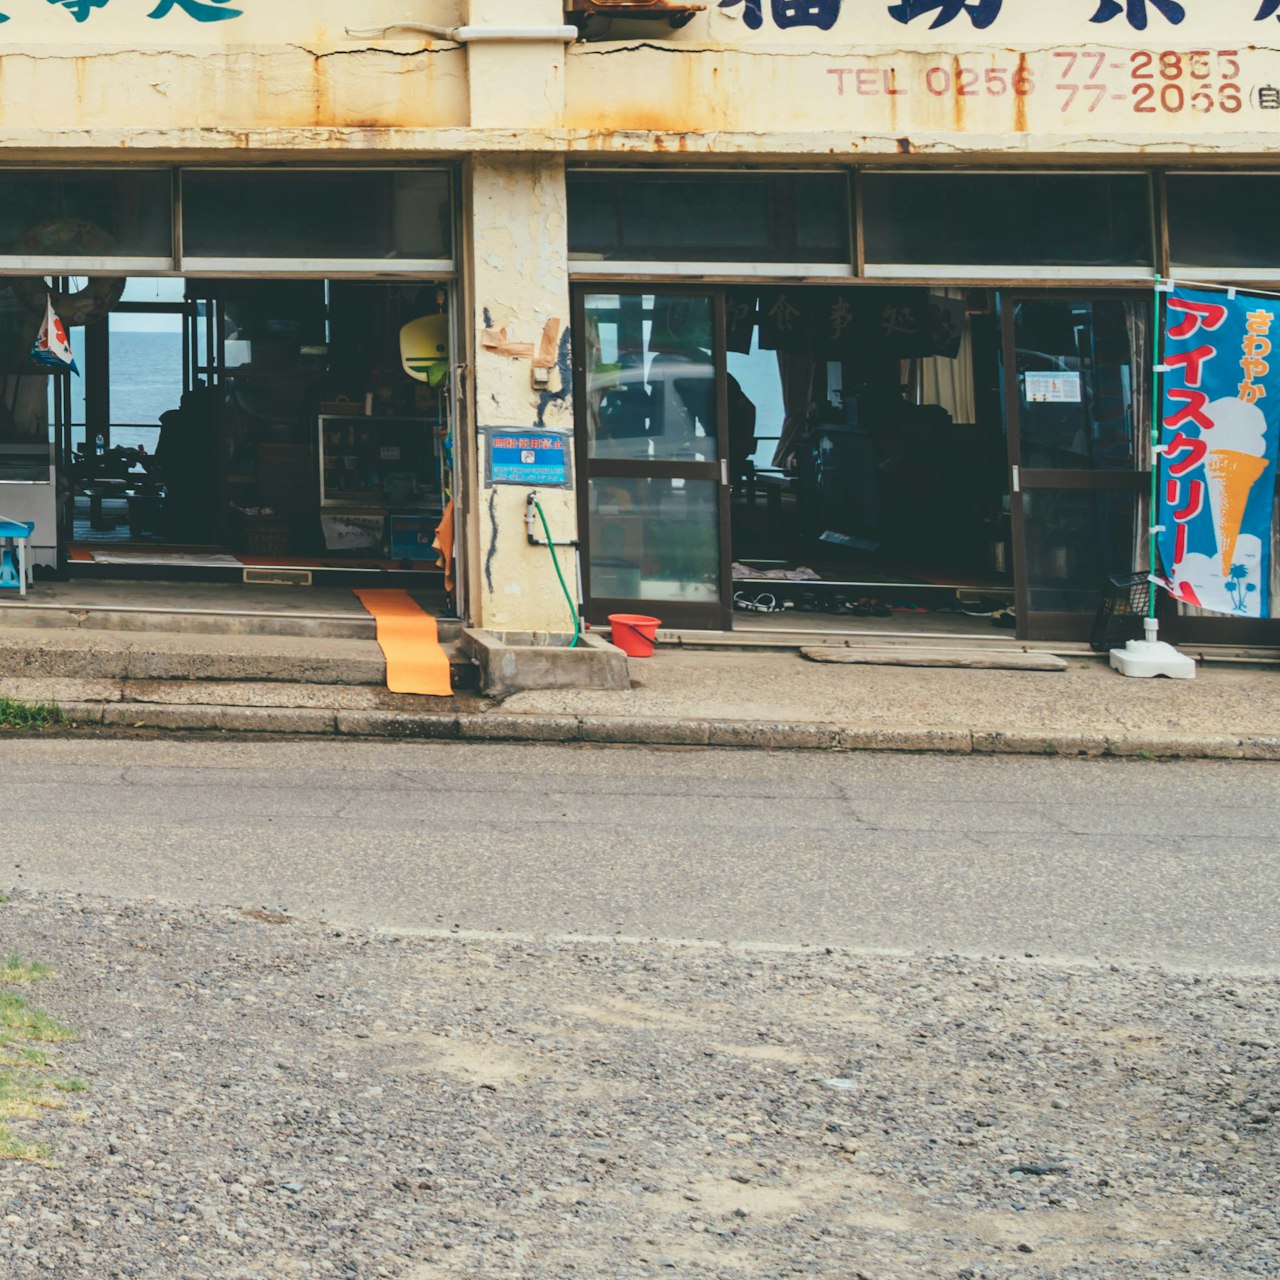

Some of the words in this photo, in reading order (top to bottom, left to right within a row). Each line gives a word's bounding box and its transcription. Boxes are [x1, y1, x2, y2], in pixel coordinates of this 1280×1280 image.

[827, 68, 907, 95] TEL
[925, 67, 1036, 97] 0256
[1238, 309, 1274, 404] さわやか
